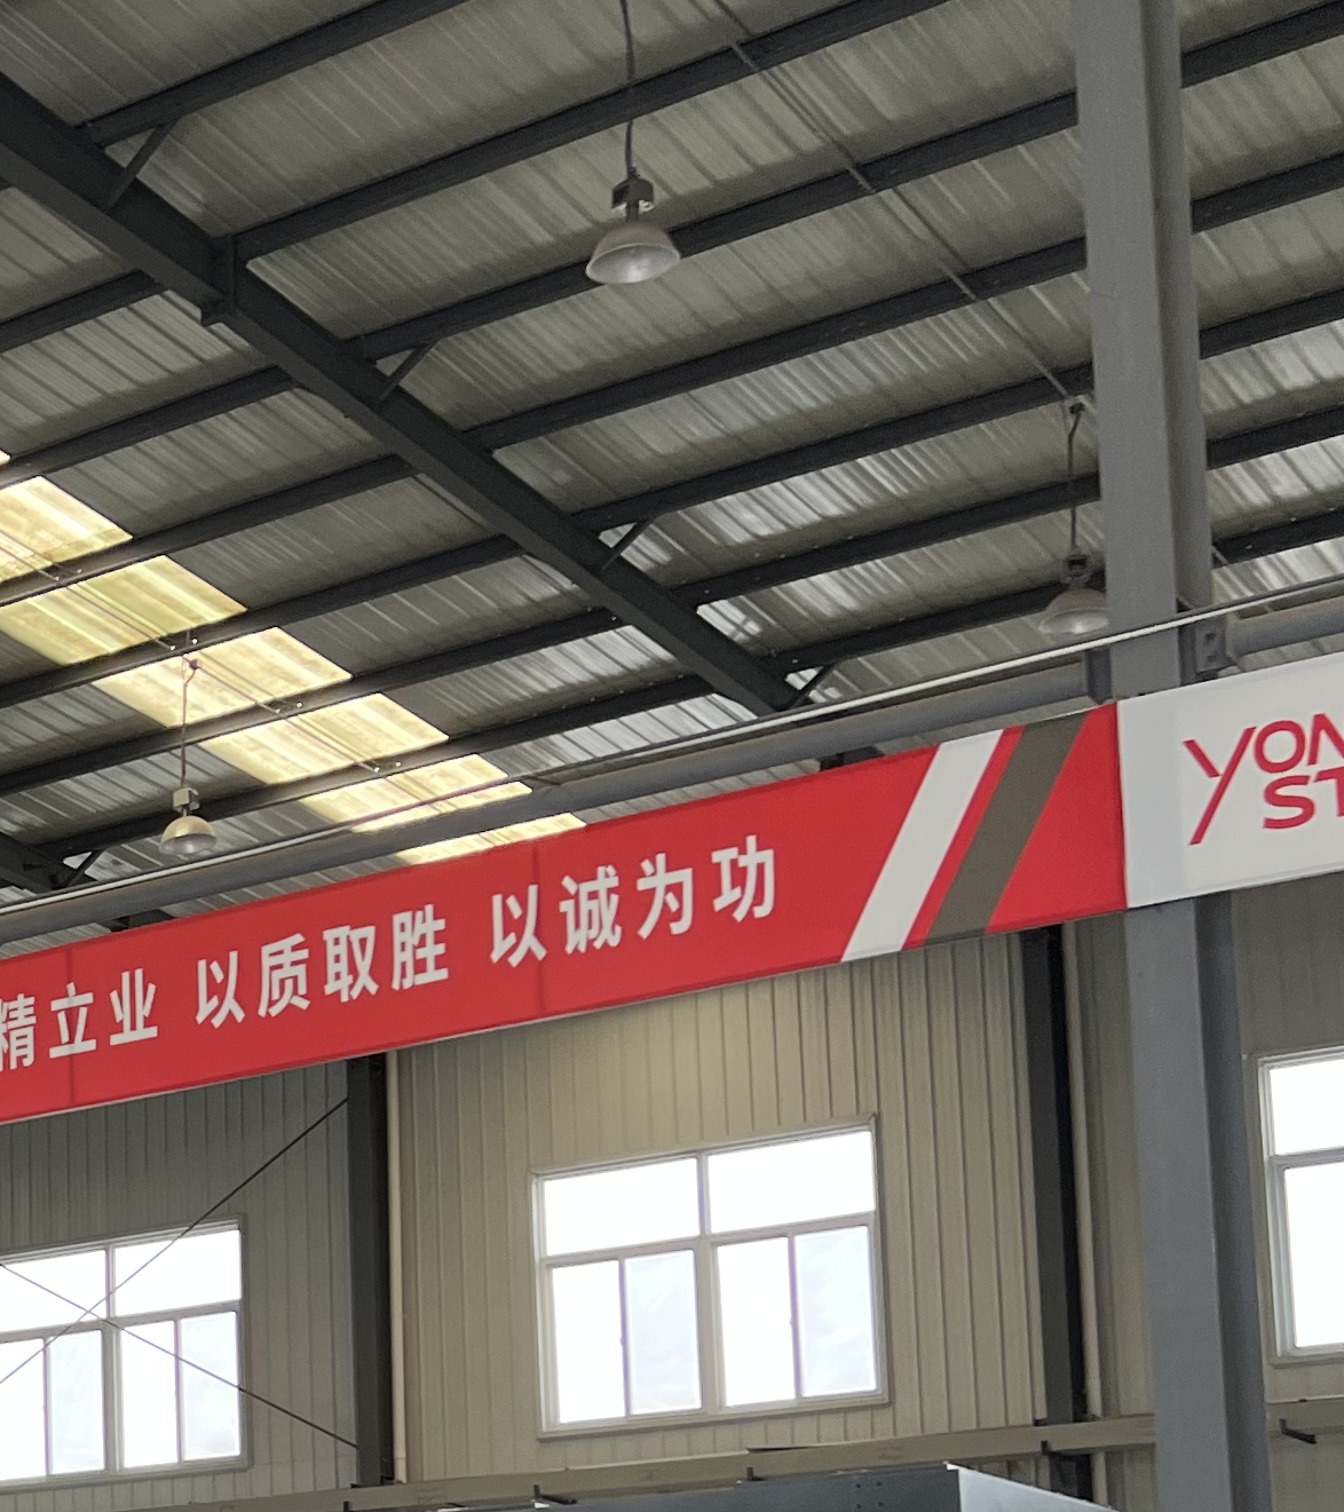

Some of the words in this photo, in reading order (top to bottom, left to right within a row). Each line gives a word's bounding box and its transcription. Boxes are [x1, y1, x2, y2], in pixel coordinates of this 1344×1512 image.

[195, 903, 450, 1028] 以质取胜
[490, 834, 778, 966] 以诚为功
